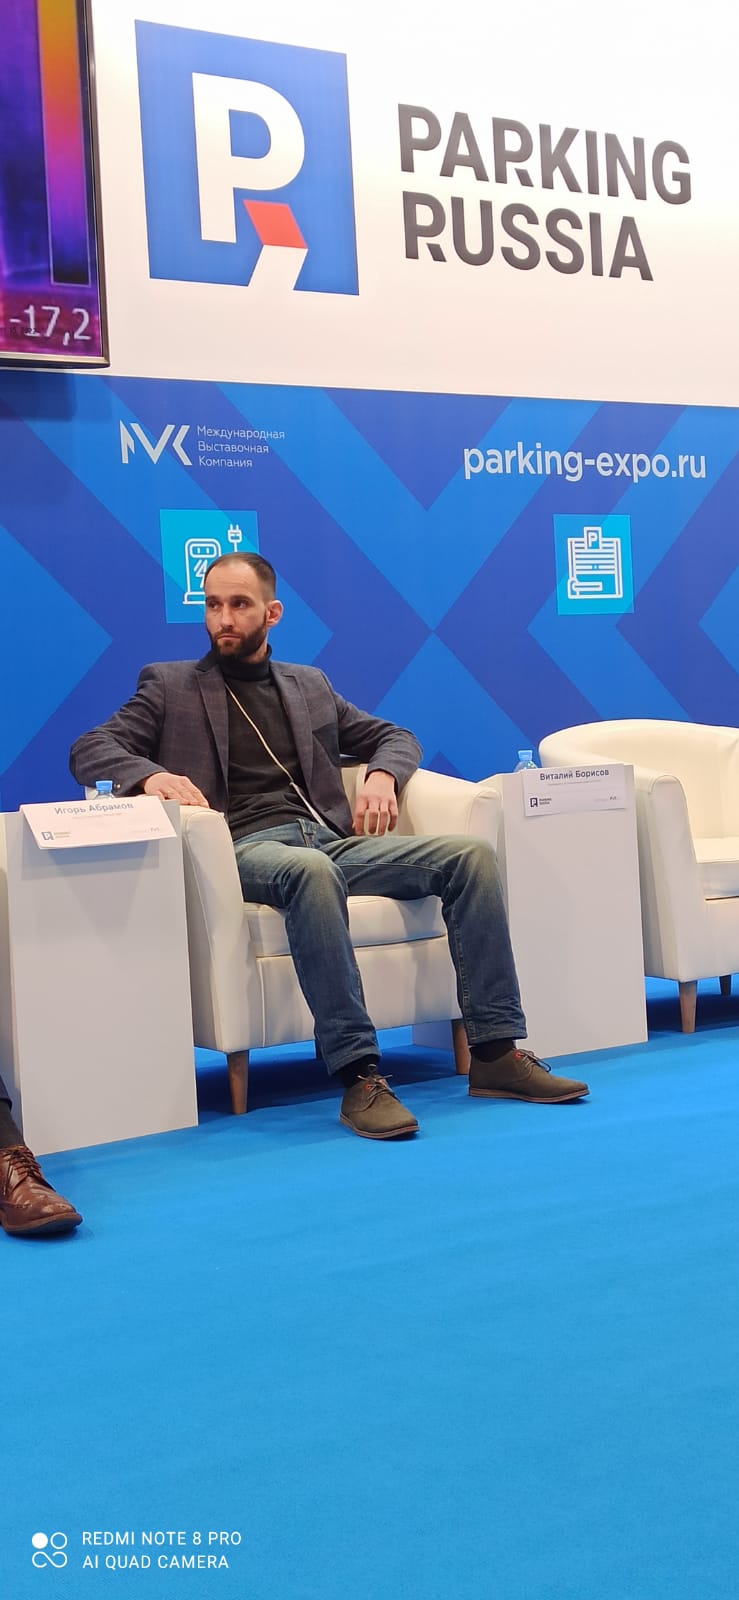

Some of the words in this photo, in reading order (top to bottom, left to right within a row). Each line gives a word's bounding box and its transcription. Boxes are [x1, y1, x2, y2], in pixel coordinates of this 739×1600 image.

[397, 103, 693, 205] PARKING
[402, 190, 654, 282] RUSSIA
[9, 304, 93, 346] -17,2
[196, 425, 286, 441] Международная
[197, 440, 270, 455] Выставочная
[198, 456, 254, 468] Компания
[463, 441, 707, 484] parking-expo.ru
[539, 770, 574, 781] Виталий
[575, 768, 610, 779] Борисов
[54, 805, 87, 816] Игорь
[88, 802, 135, 813] Абрамов
